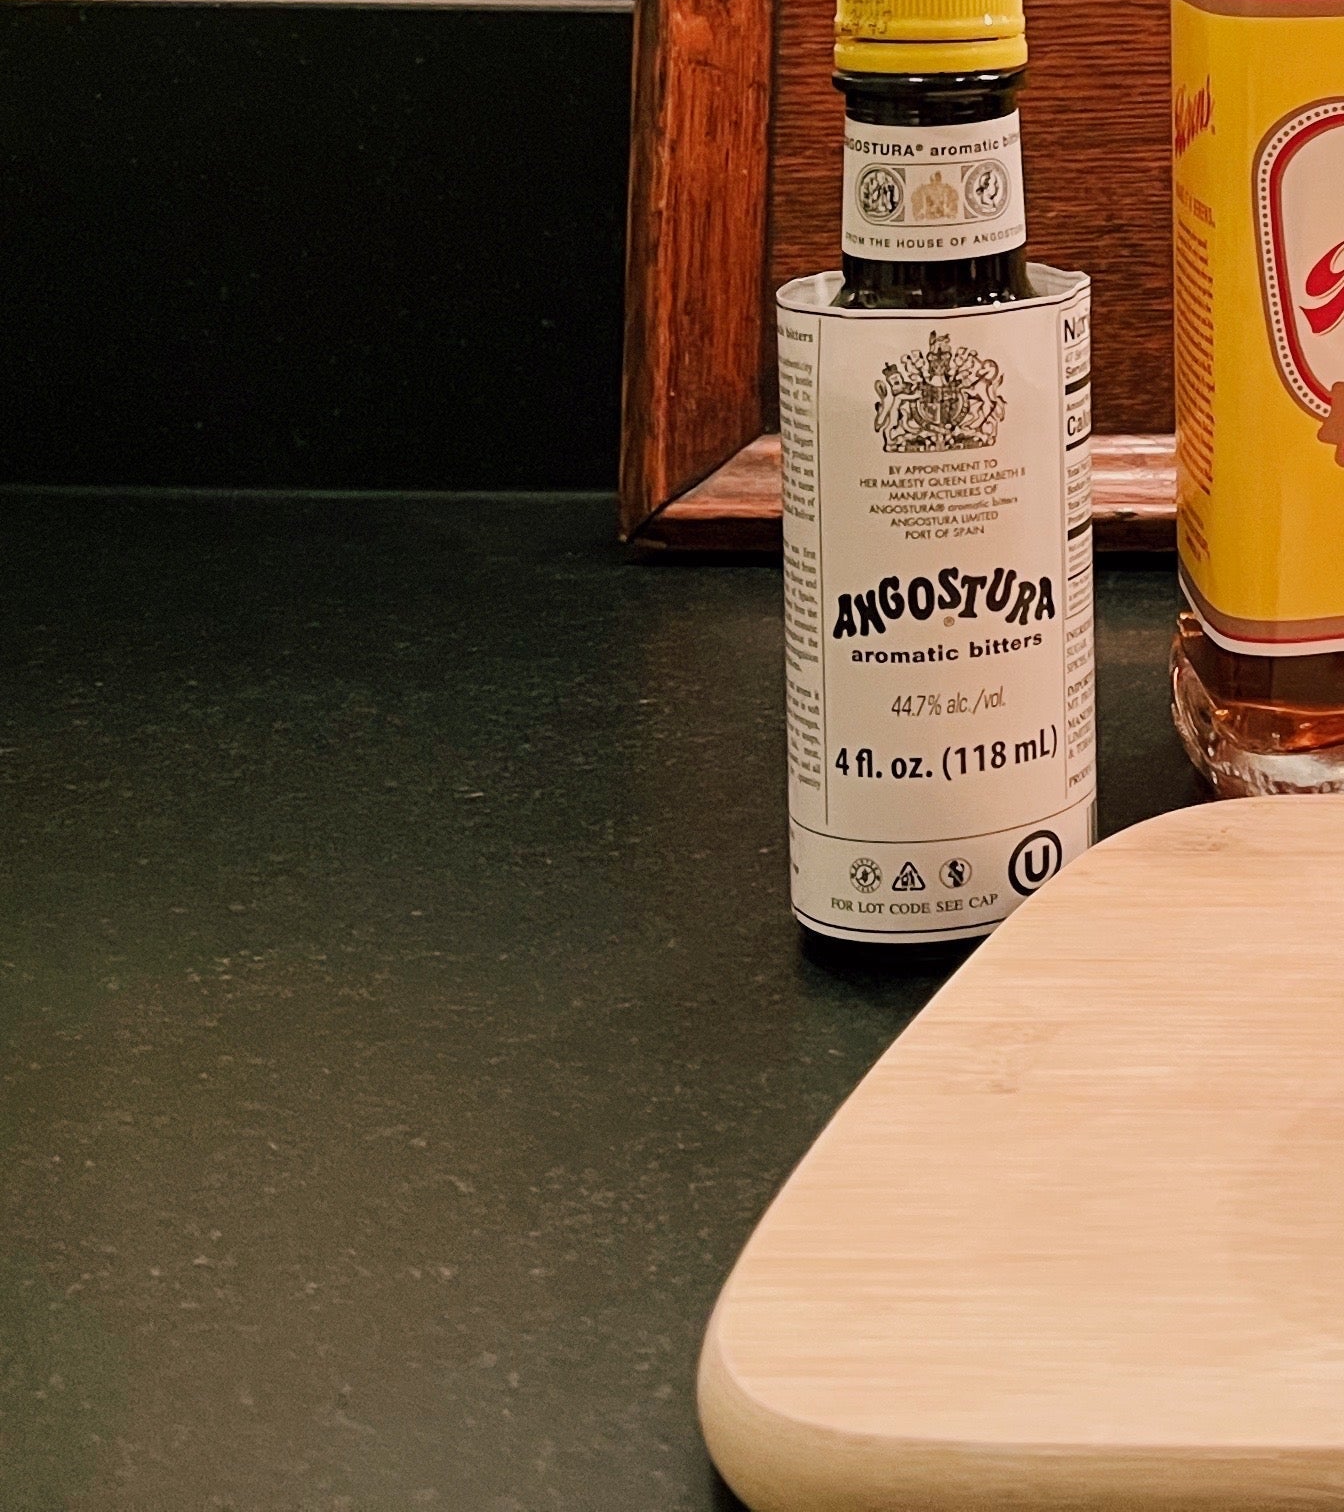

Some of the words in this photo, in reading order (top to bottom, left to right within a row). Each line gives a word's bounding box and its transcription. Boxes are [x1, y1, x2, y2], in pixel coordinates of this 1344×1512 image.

[930, 139, 999, 157] aromatic
[869, 237, 890, 248] THE
[896, 238, 944, 249] HOUSE
[950, 236, 966, 247] OF
[889, 465, 901, 476] BY
[905, 461, 980, 475] APPOINTMENT
[984, 458, 998, 469] TO
[859, 477, 877, 488] HER
[928, 474, 967, 487] QUEEN
[970, 468, 1019, 484] ELIZABETH
[890, 515, 959, 528] ANGOSTURA
[961, 510, 999, 524] LIMITED
[904, 528, 932, 540] PORT
[935, 526, 949, 538] OF
[953, 524, 985, 537] SPAIN
[833, 568, 1055, 639] ANGOSTURA
[851, 645, 958, 664] aromatic
[969, 633, 1043, 659] bitters
[891, 694, 942, 717] 44.7%
[835, 747, 850, 776] 4
[856, 748, 883, 778] fl.
[891, 757, 933, 779] oz.
[942, 742, 1007, 781] (118
[1014, 724, 1058, 764] mL)
[831, 897, 853, 912] FOR
[858, 901, 885, 914] LOT
[889, 902, 932, 915] CODE
[936, 898, 964, 913] SEE
[968, 893, 999, 909] CAP
